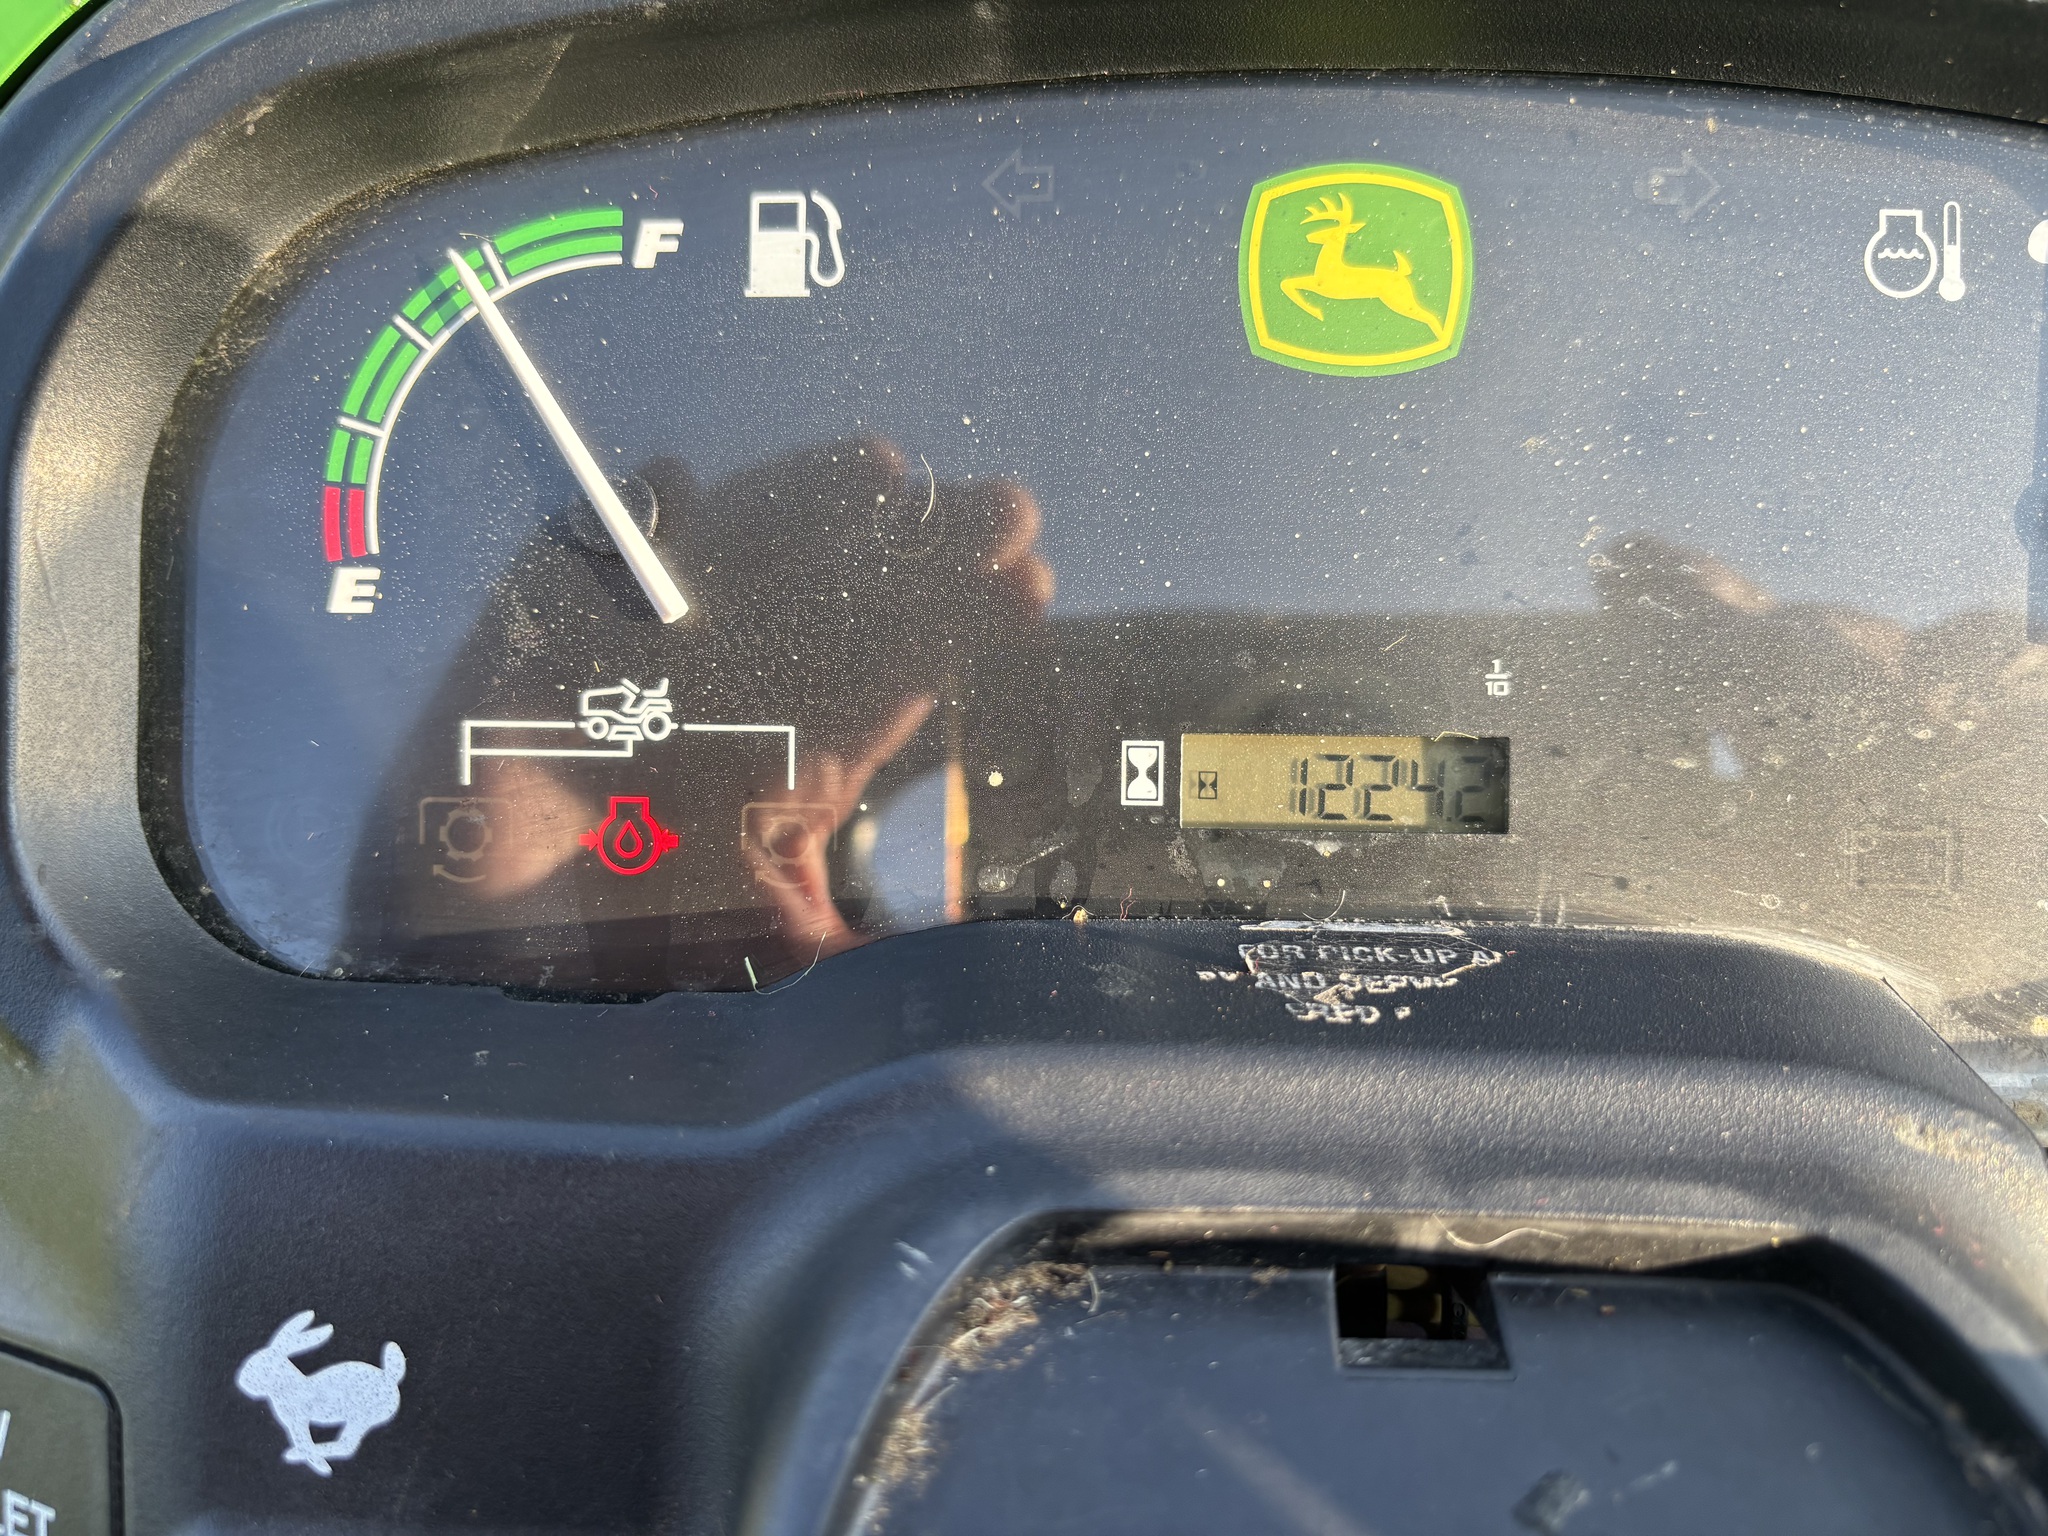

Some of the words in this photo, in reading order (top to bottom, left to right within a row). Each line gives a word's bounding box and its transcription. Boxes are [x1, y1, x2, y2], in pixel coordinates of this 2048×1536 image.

[632, 219, 684, 269] F
[326, 567, 381, 613] E
[1254, 970, 1327, 989] AND
